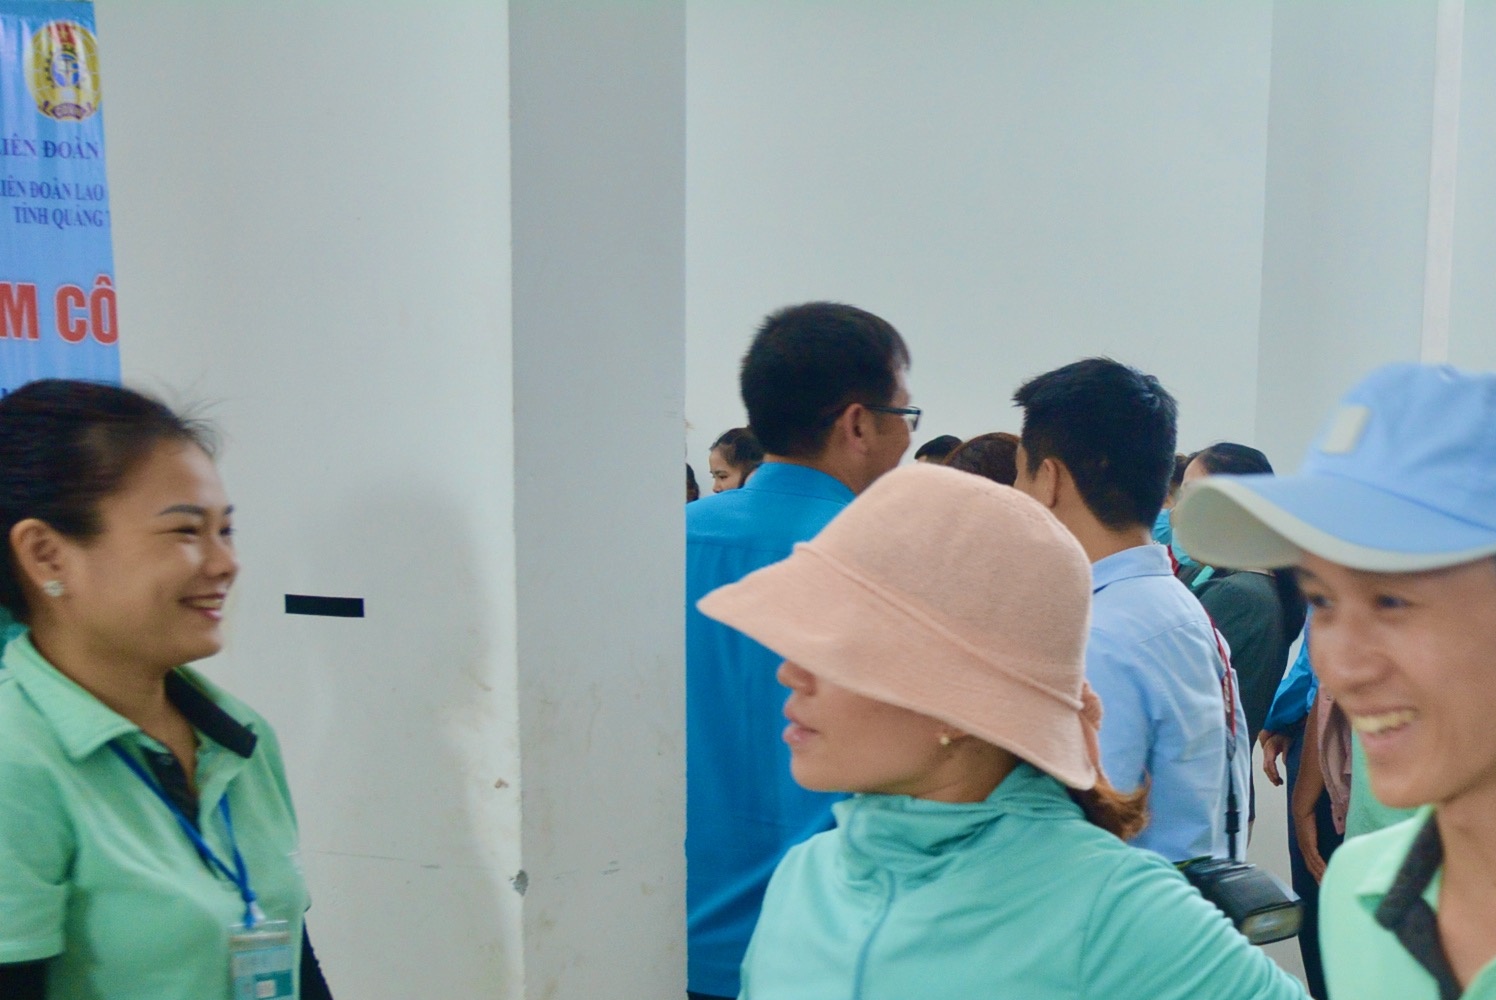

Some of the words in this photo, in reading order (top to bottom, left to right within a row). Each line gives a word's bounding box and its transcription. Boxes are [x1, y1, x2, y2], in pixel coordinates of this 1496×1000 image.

[0, 133, 37, 156] IÊN
[0, 175, 26, 197] IÊN
[75, 183, 104, 201] LAO
[56, 274, 118, 345] CÔ
